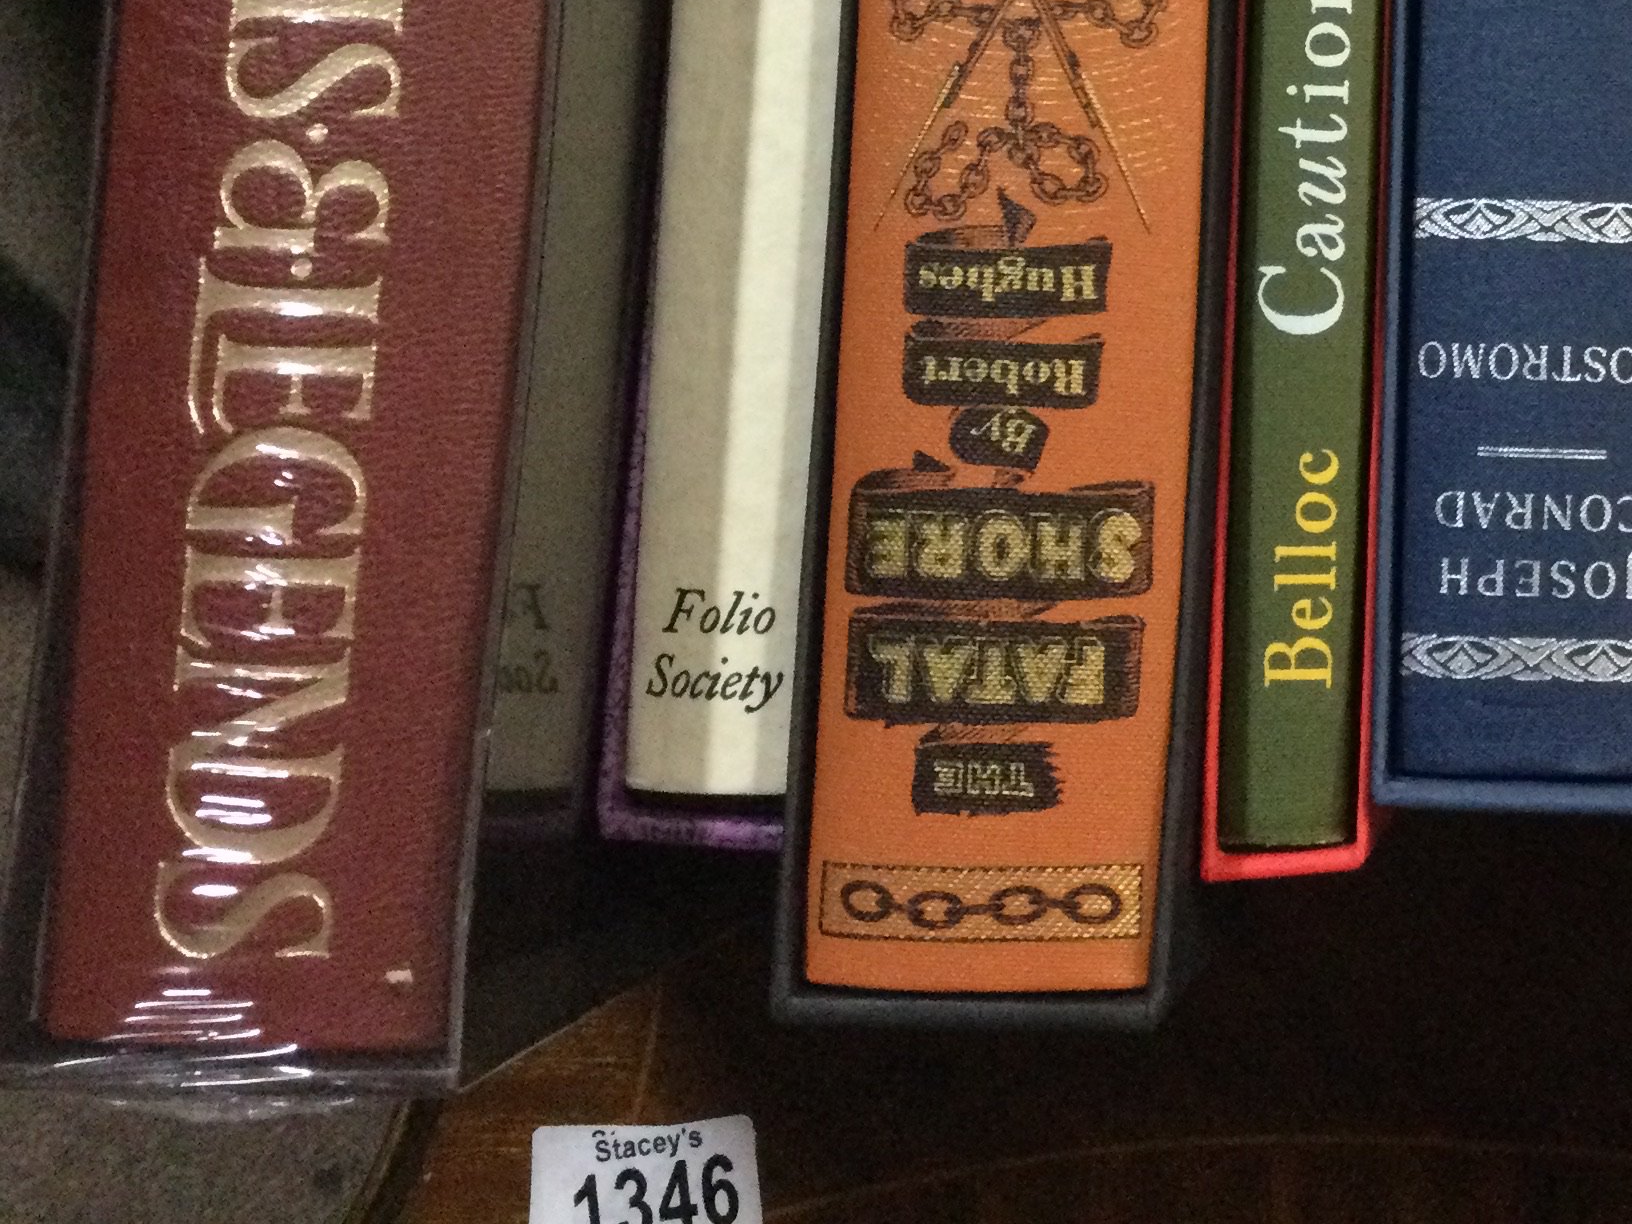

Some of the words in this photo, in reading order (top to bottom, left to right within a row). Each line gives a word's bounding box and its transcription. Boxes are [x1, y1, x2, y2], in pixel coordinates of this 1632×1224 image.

[918, 256, 1099, 303] Hughes
[922, 356, 1087, 397] Robert
[970, 404, 1037, 453] By
[864, 508, 1142, 583] SHORE
[1263, 448, 1340, 690] Belloc
[662, 587, 777, 636] Folio
[645, 653, 784, 713] Society
[869, 635, 1105, 705] FATAL
[933, 761, 1035, 797] THE
[594, 1127, 703, 1163] Stacey's
[573, 1153, 740, 1224] 1346
